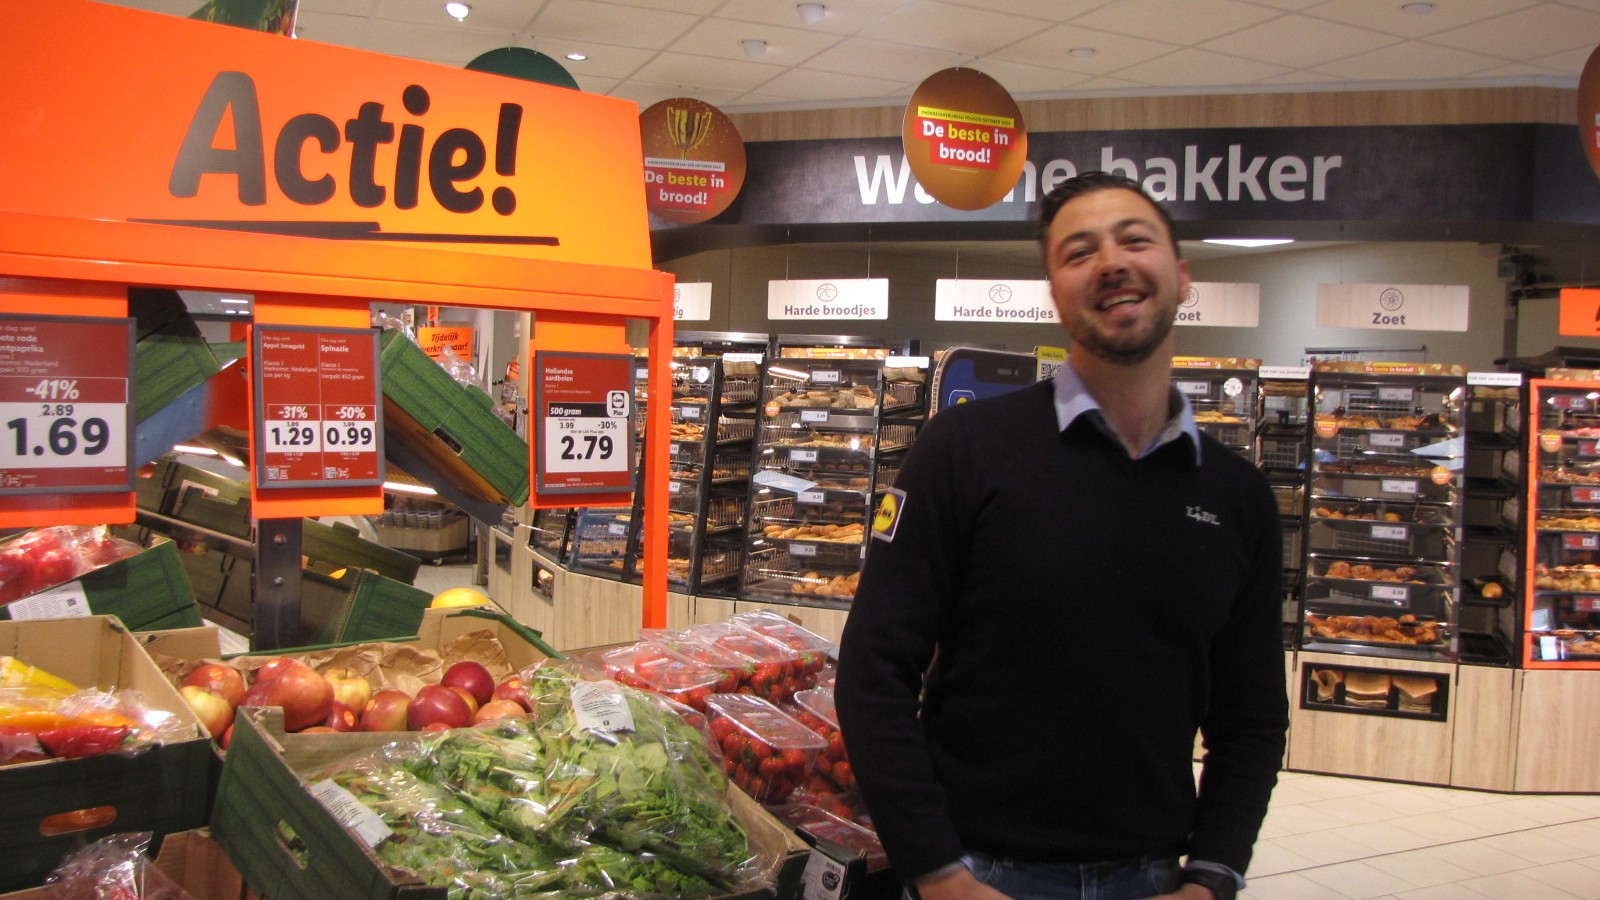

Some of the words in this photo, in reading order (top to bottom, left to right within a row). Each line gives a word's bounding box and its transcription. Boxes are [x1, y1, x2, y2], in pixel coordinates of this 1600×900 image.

[922, 120, 944, 138] De
[948, 123, 990, 143] beste
[993, 128, 1009, 146] in
[168, 70, 523, 217] Actie!
[939, 142, 991, 164] brood!
[645, 170, 664, 184] De
[668, 171, 707, 187] beste
[711, 174, 724, 188] in
[660, 188, 708, 205] brood!
[784, 304, 819, 316] Harde
[823, 303, 876, 320] broodjes
[953, 306, 992, 318] Harde
[996, 306, 1054, 321] broodjes
[1371, 312, 1406, 326] Zoet
[17, 334, 38, 343] rode
[263, 342, 280, 350] Appel
[280, 343, 306, 351] Jonagold
[320, 344, 350, 353] Spinazie
[545, 368, 574, 376] Hollandse
[26, 379, 80, 400] -41%
[42, 404, 74, 417] 2.89
[279, 406, 308, 419] -31%
[336, 407, 366, 420] -50%
[550, 407, 564, 415] 500
[597, 421, 618, 430] -30%
[7, 417, 110, 456] 1.69
[271, 427, 315, 446] 1.29
[326, 427, 373, 446] 0.99
[561, 435, 614, 460] 2.79
